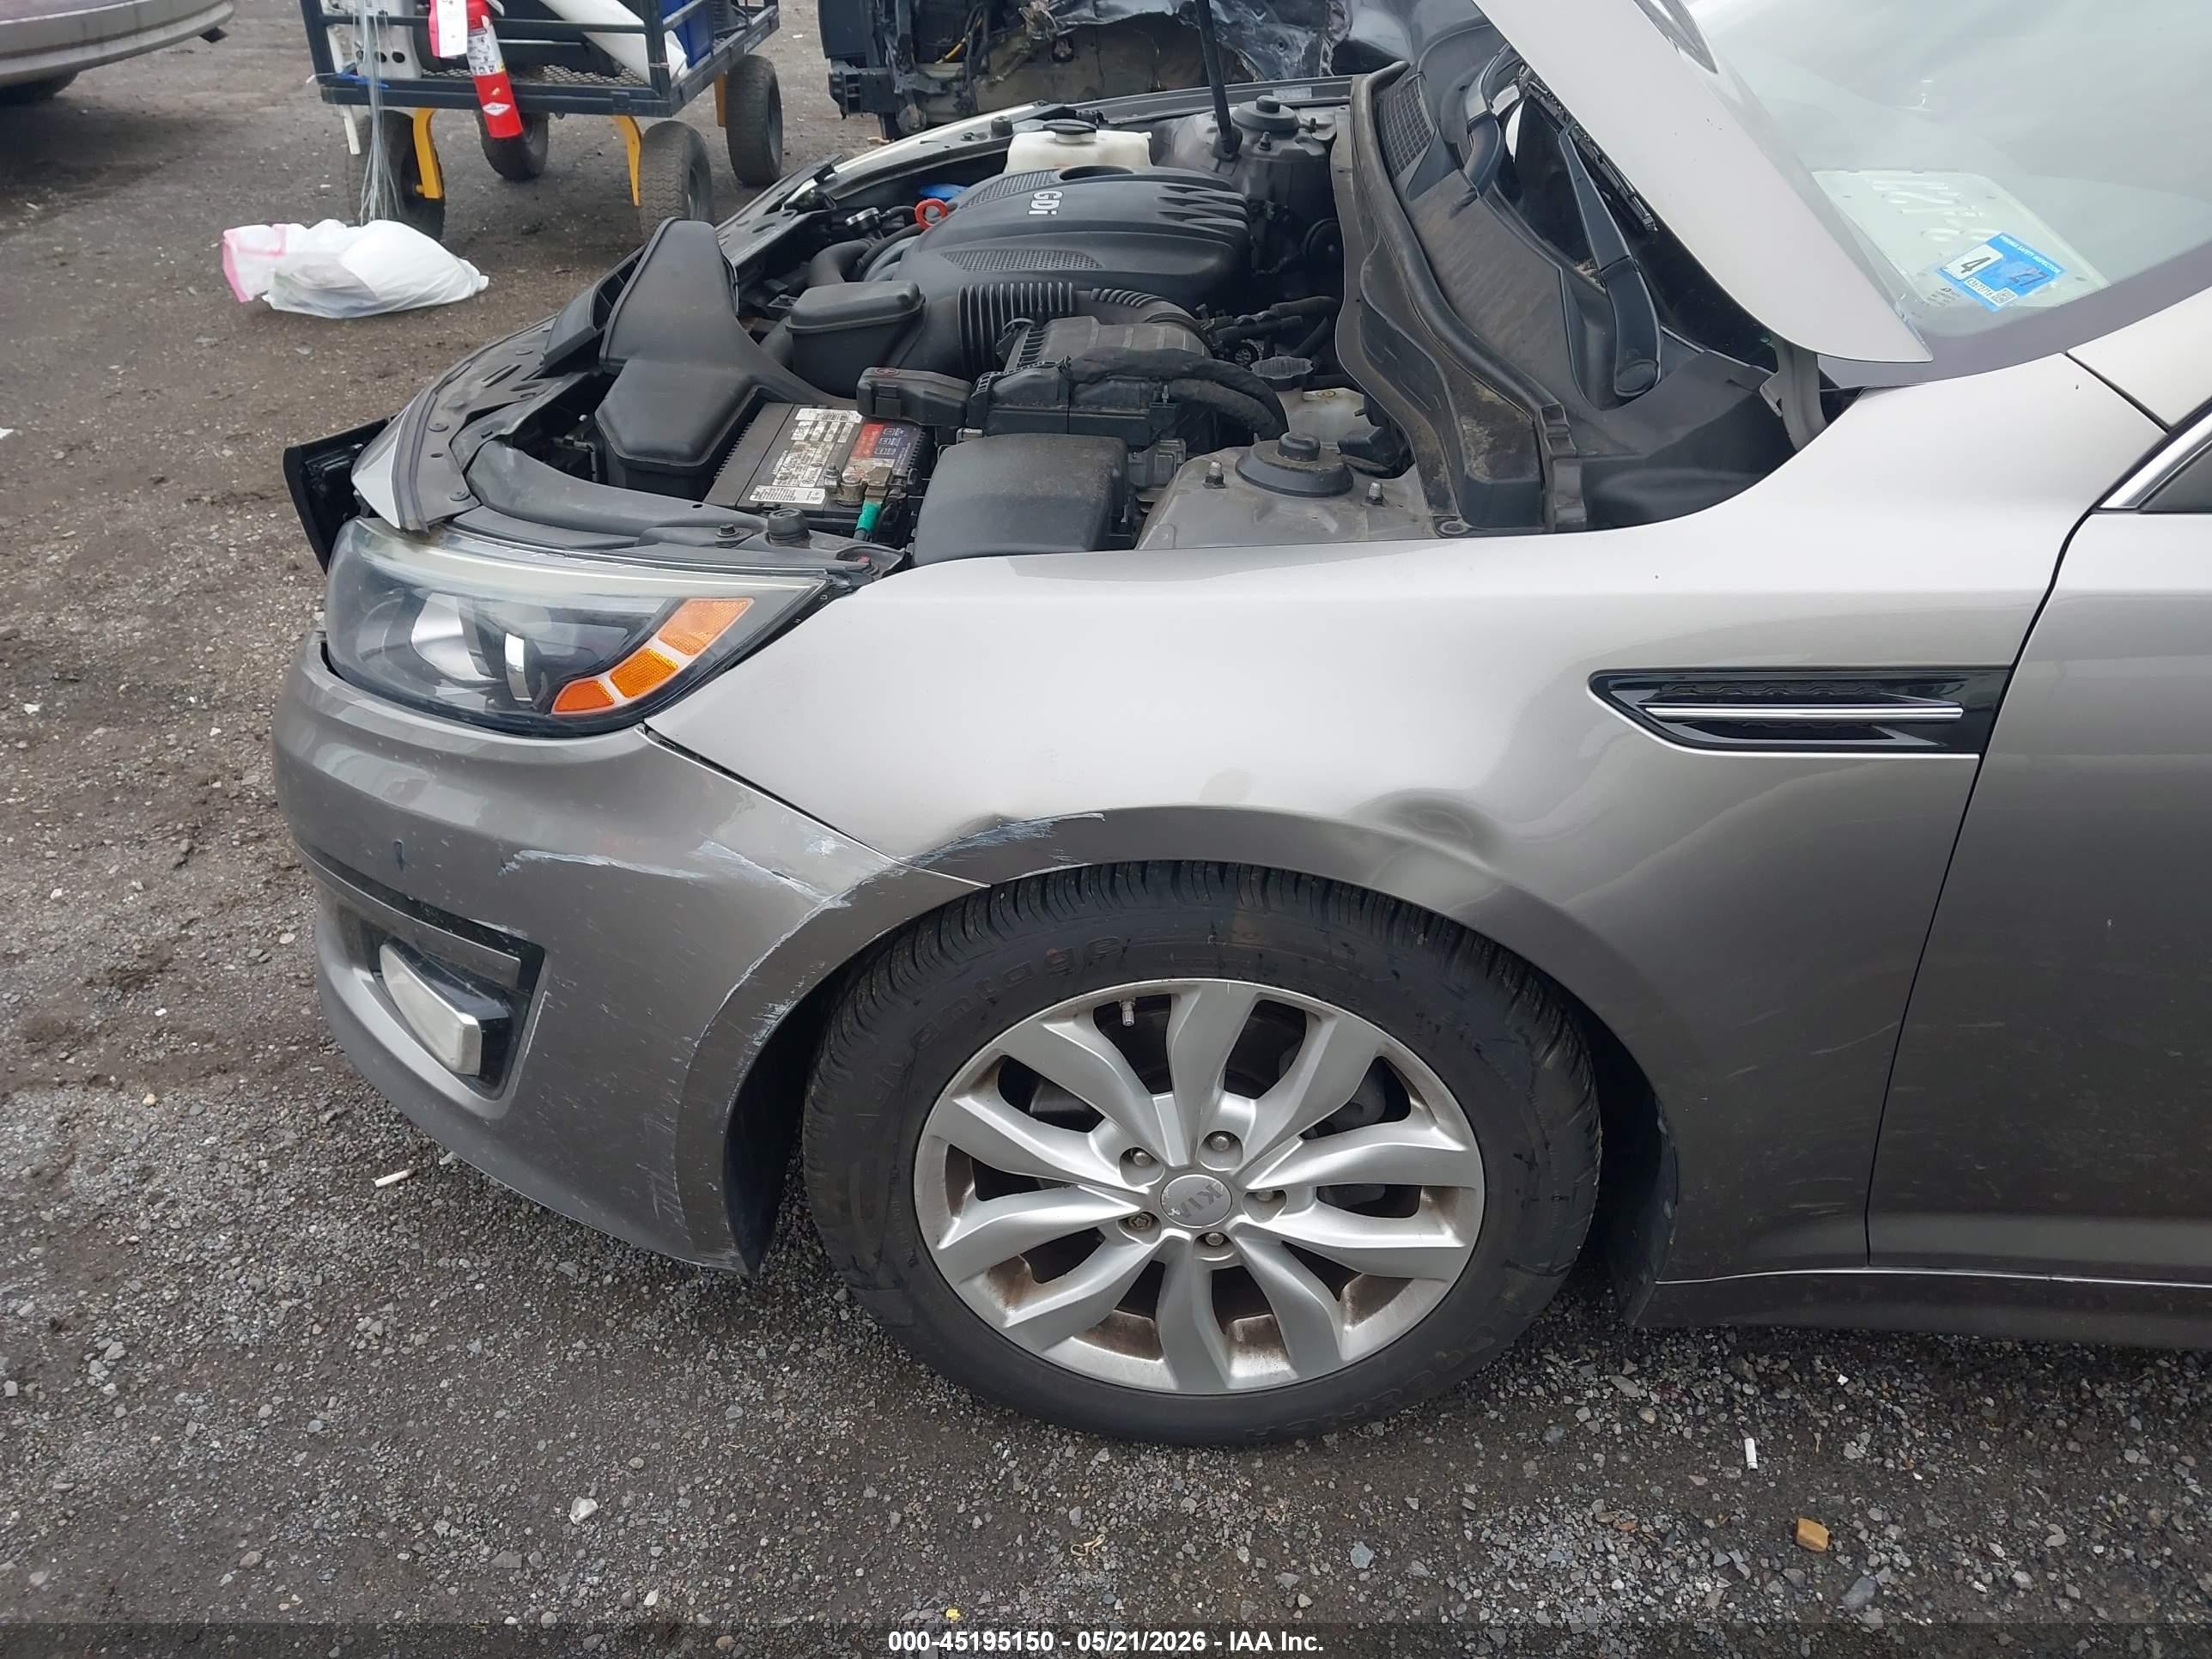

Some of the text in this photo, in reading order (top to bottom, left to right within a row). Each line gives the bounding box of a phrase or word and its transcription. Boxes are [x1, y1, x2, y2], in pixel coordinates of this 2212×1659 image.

[1028, 191, 1063, 215] GDi
[1960, 256, 1991, 274] 4
[1180, 1184, 1224, 1219] KIA
